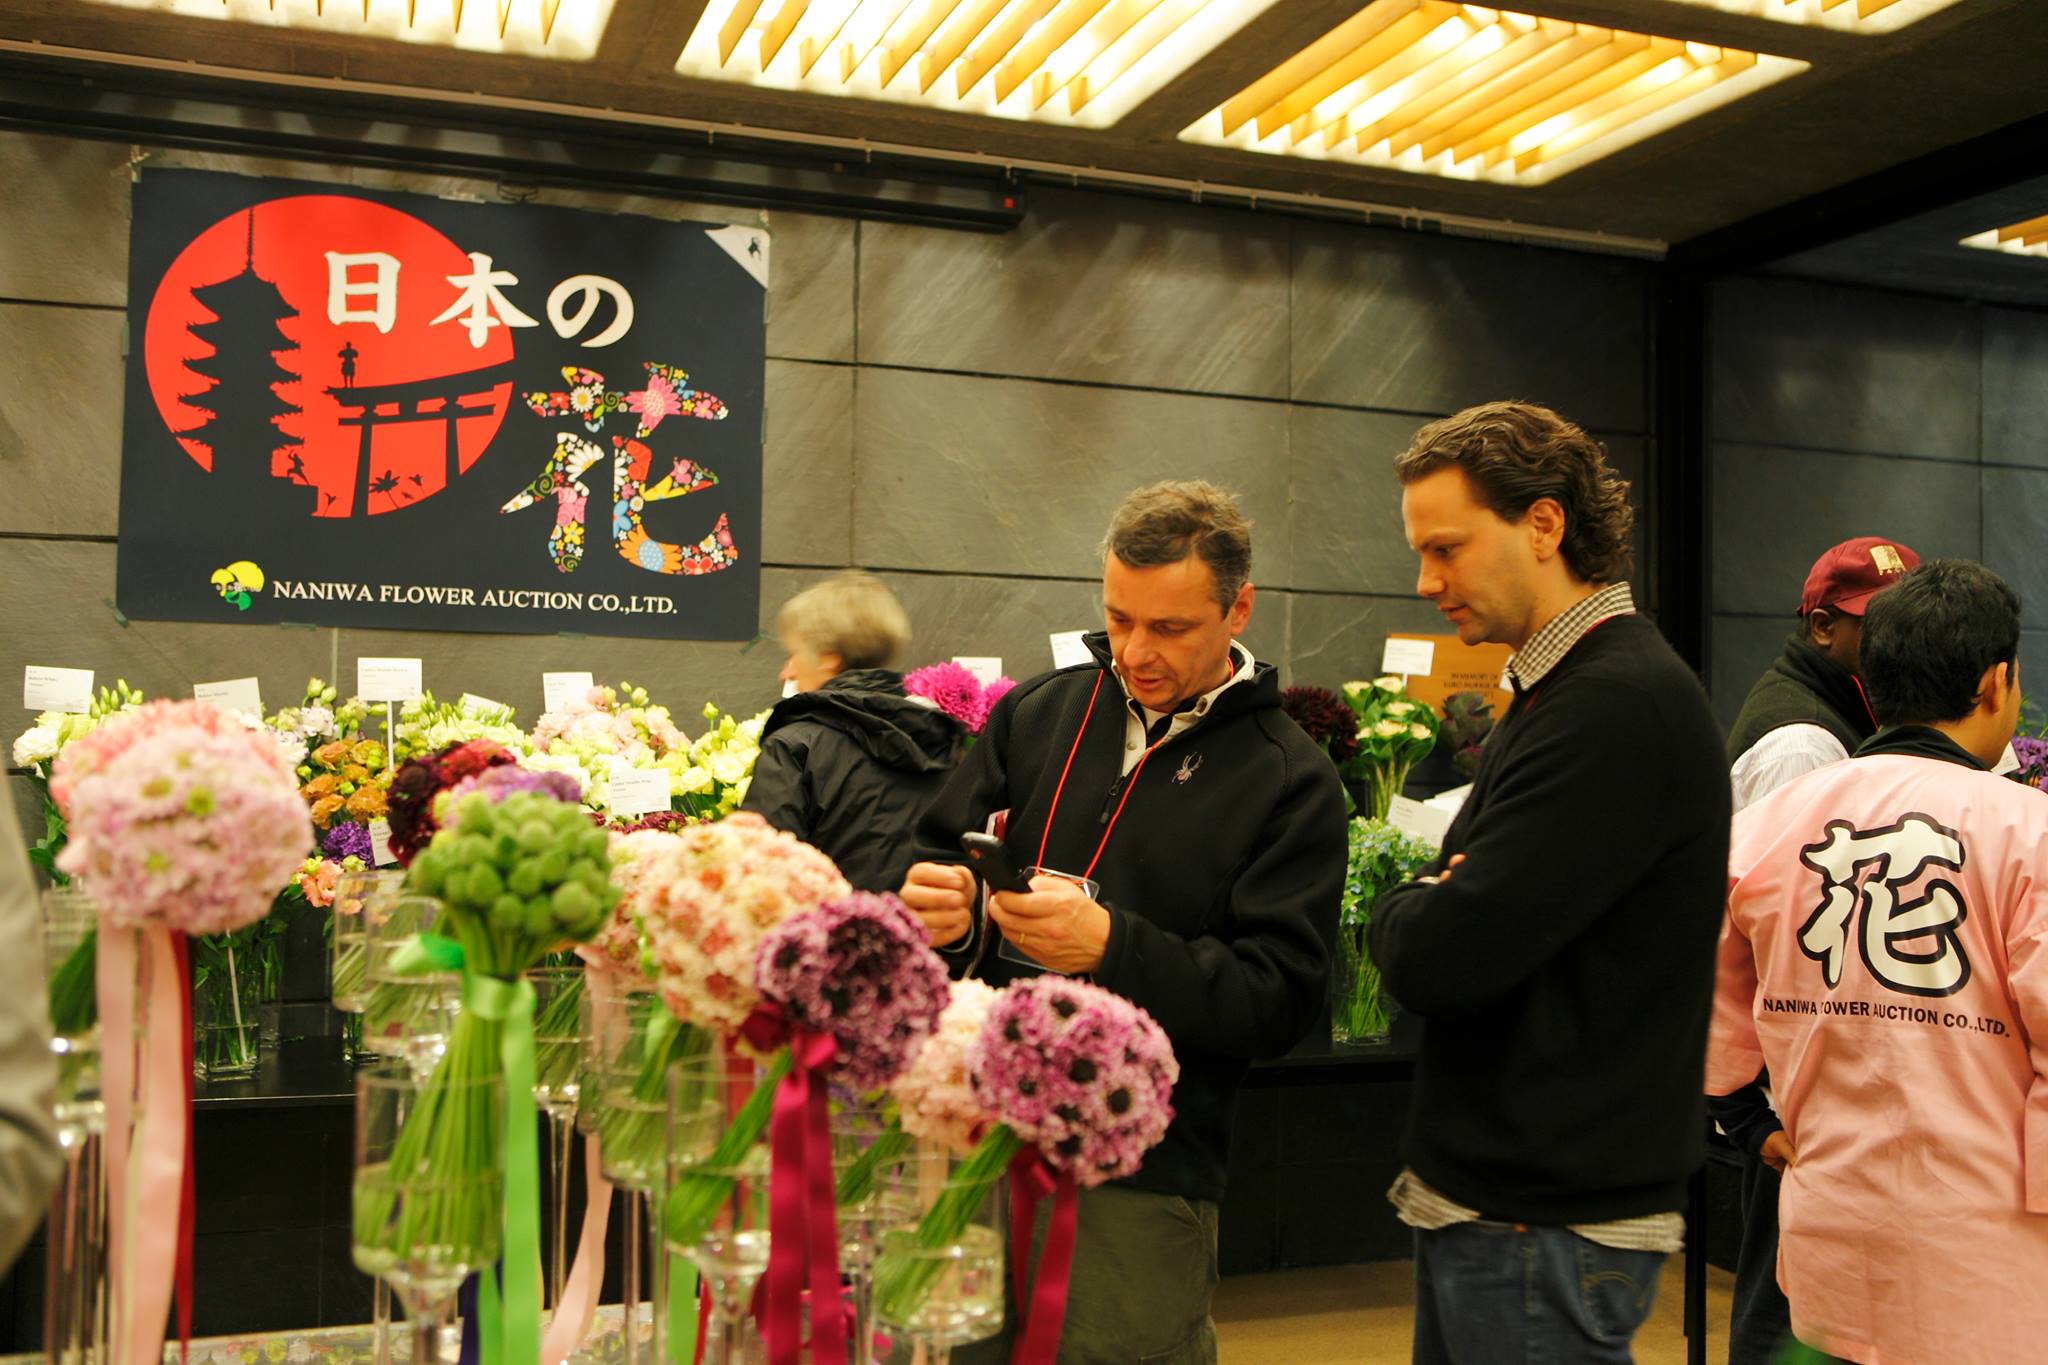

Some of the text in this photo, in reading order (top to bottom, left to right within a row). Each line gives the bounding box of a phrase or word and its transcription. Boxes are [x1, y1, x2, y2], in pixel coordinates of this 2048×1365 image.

[324, 251, 635, 349] 日本の
[500, 361, 738, 576] 花
[273, 580, 374, 602] NANIWA
[379, 585, 477, 606] FLOWER
[480, 588, 583, 610] AUCTION
[588, 593, 678, 615] CO.,LTD.
[1797, 811, 1971, 998] 花
[1763, 998, 2010, 1038] NANIWA OWER AUCTION CO.,LTD.
